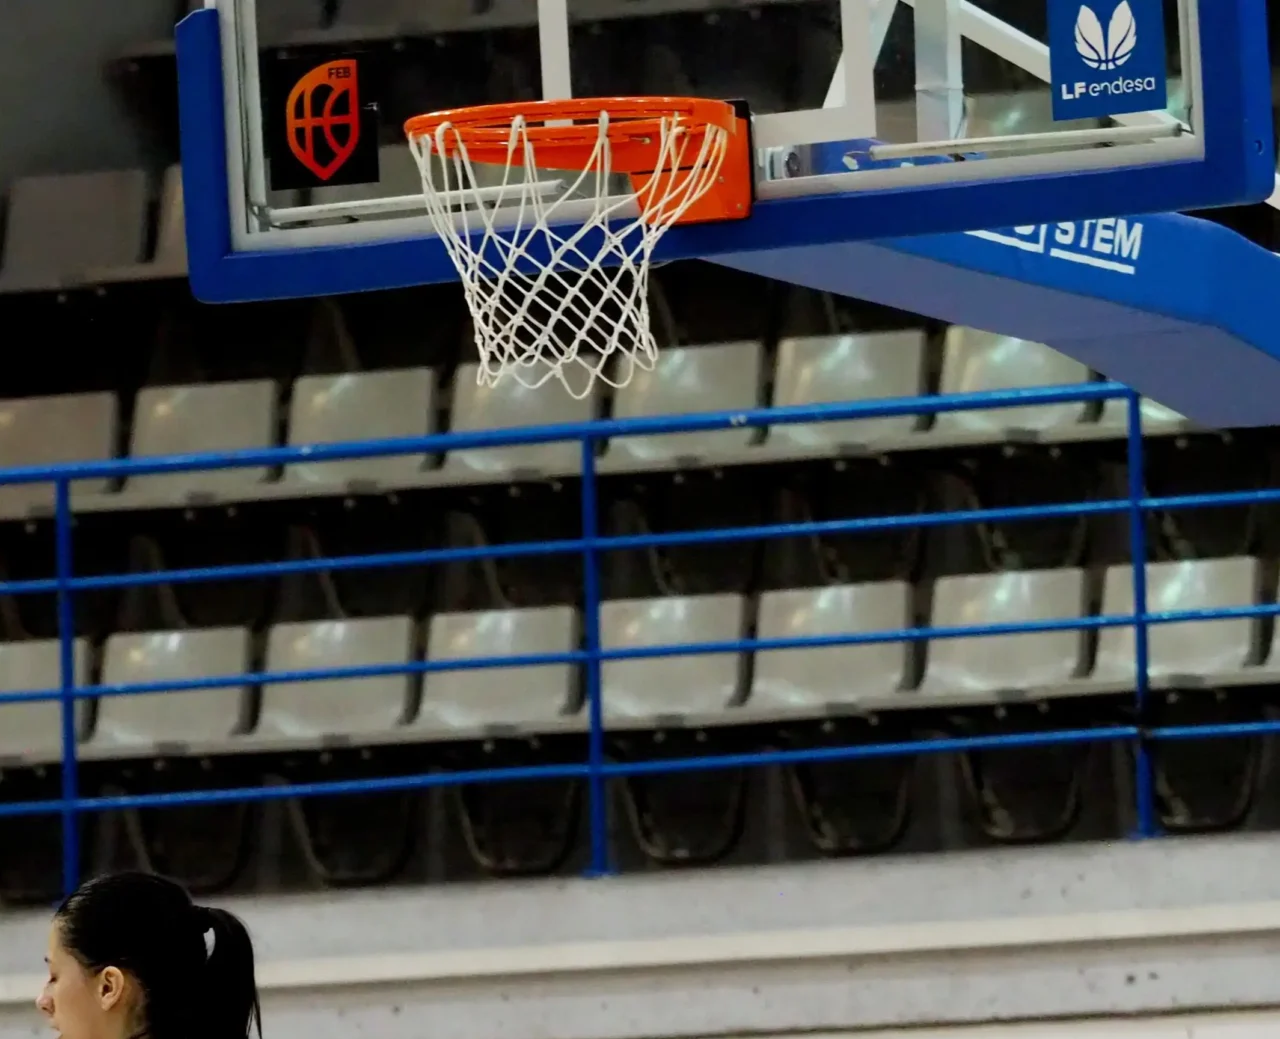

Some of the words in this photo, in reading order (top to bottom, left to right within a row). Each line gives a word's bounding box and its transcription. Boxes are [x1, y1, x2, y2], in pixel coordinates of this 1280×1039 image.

[328, 67, 351, 79] FEB
[1061, 82, 1086, 100] LF
[1088, 77, 1156, 97] endesa
[1014, 217, 1144, 261] STEM
